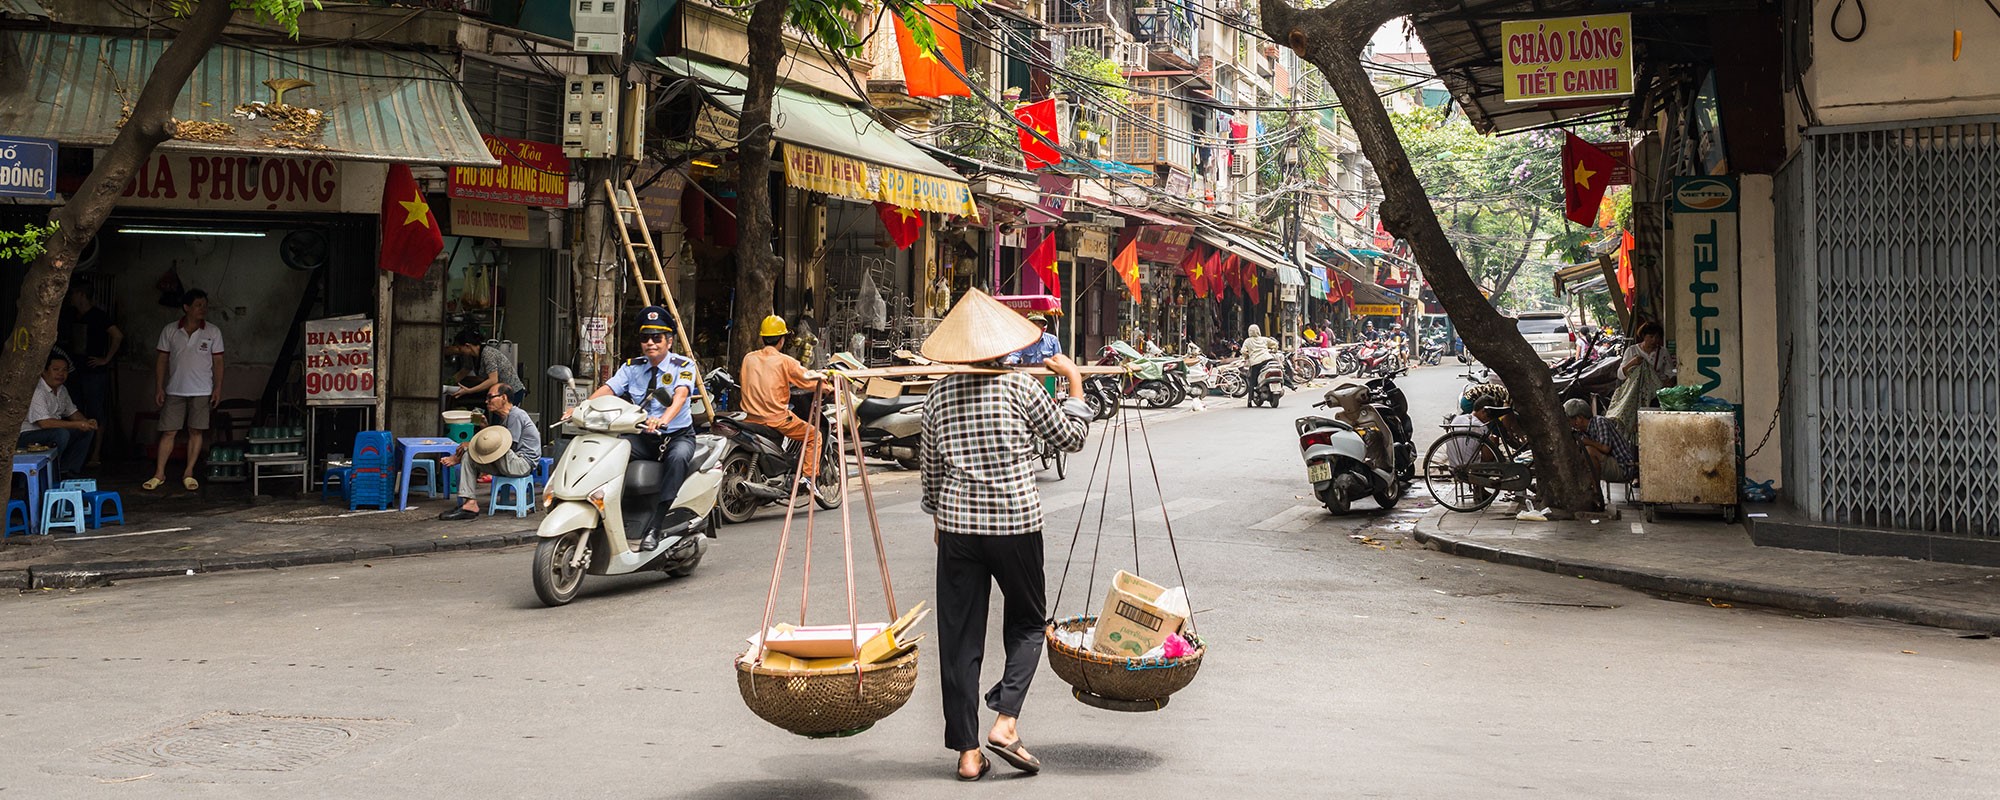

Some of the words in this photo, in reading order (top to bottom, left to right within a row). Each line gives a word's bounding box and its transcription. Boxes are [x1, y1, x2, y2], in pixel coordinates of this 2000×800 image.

[1508, 23, 1563, 65] CHÁO
[1567, 20, 1623, 60] LÒNG
[1516, 65, 1557, 95] TIẾT
[1562, 67, 1618, 92] CANH
[496, 165, 509, 190] 48
[511, 161, 538, 193] HÀNG
[1006, 300, 1032, 309] SOUCI
[1689, 219, 1721, 397] VIETTEL
[307, 331, 339, 345] BIA
[307, 348, 334, 368] HÀ
[336, 348, 369, 370] NỘI
